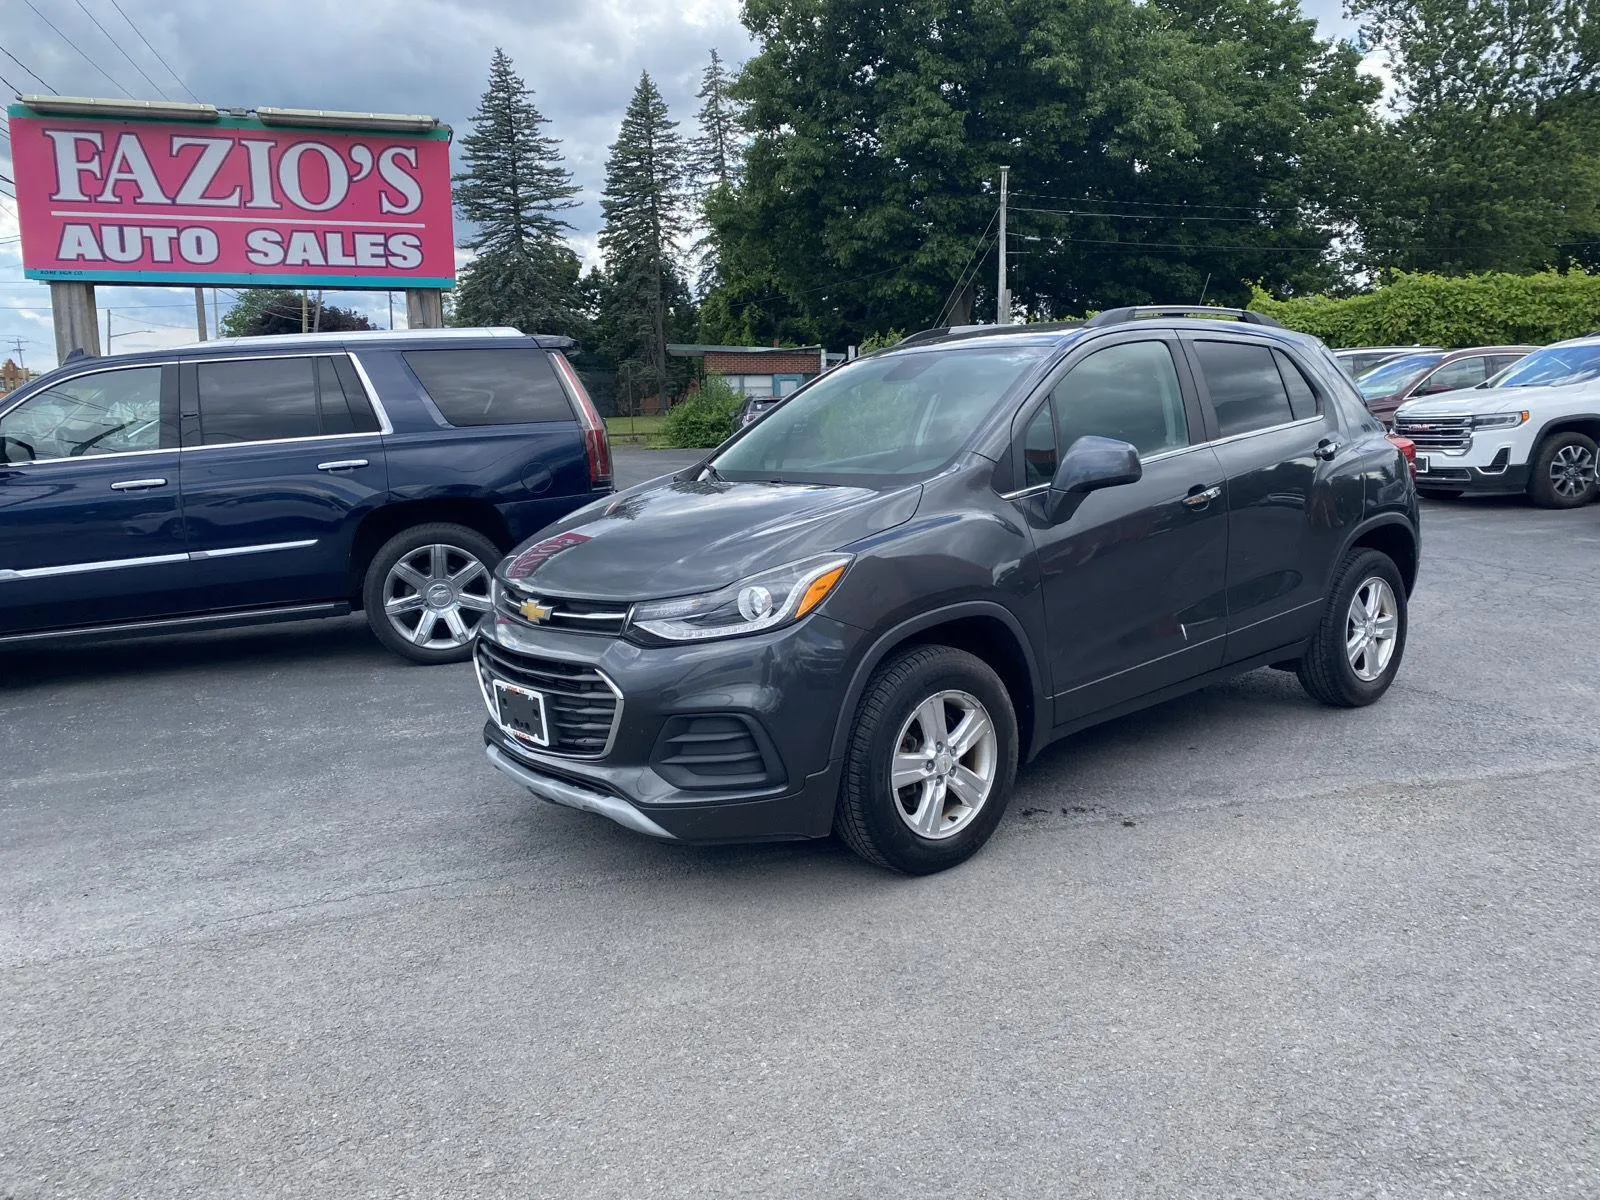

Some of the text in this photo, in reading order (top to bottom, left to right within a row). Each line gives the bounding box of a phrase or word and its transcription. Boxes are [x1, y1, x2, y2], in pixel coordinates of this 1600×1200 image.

[43, 128, 424, 215] FAZIO'S
[56, 222, 424, 270] AUTO SALES
